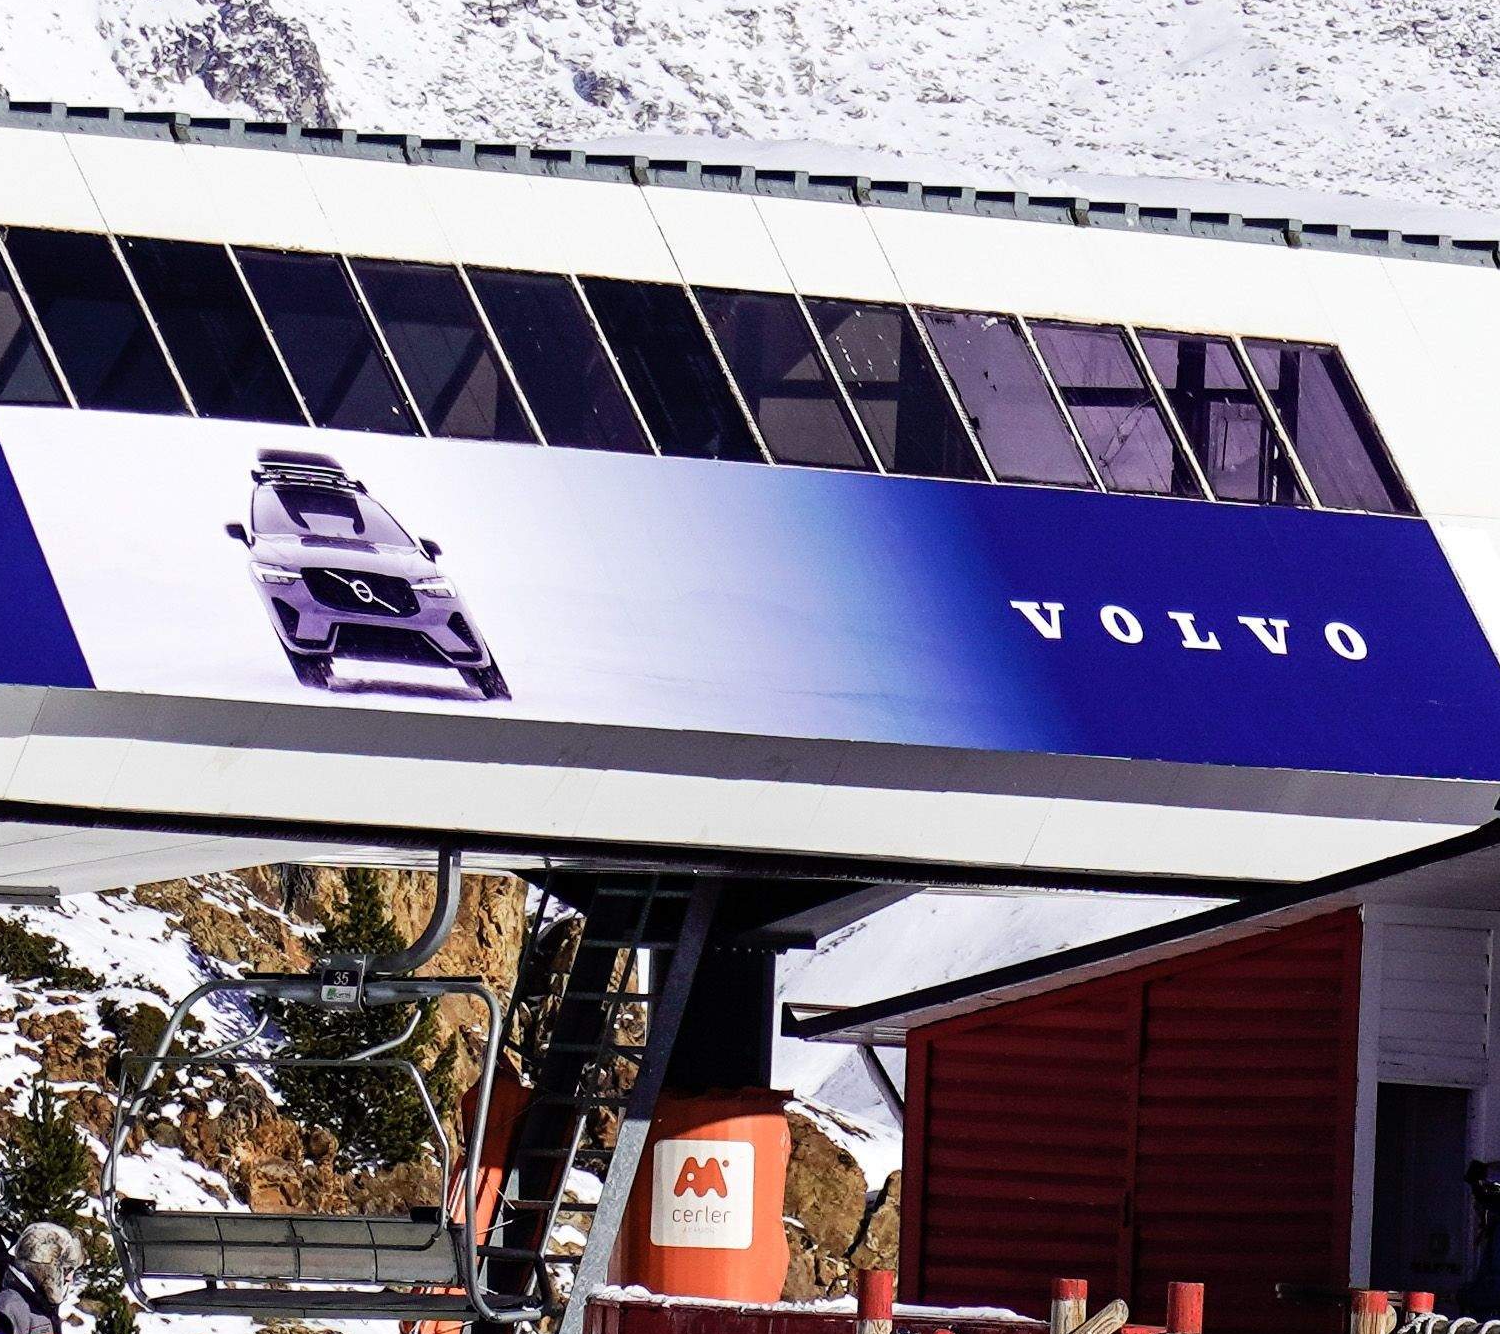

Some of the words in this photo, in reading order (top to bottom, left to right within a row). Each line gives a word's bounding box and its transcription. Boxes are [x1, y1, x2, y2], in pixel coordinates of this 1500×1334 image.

[1009, 599, 1369, 661] VOLVO
[333, 970, 349, 986] 35
[672, 1205, 732, 1223] cerler
